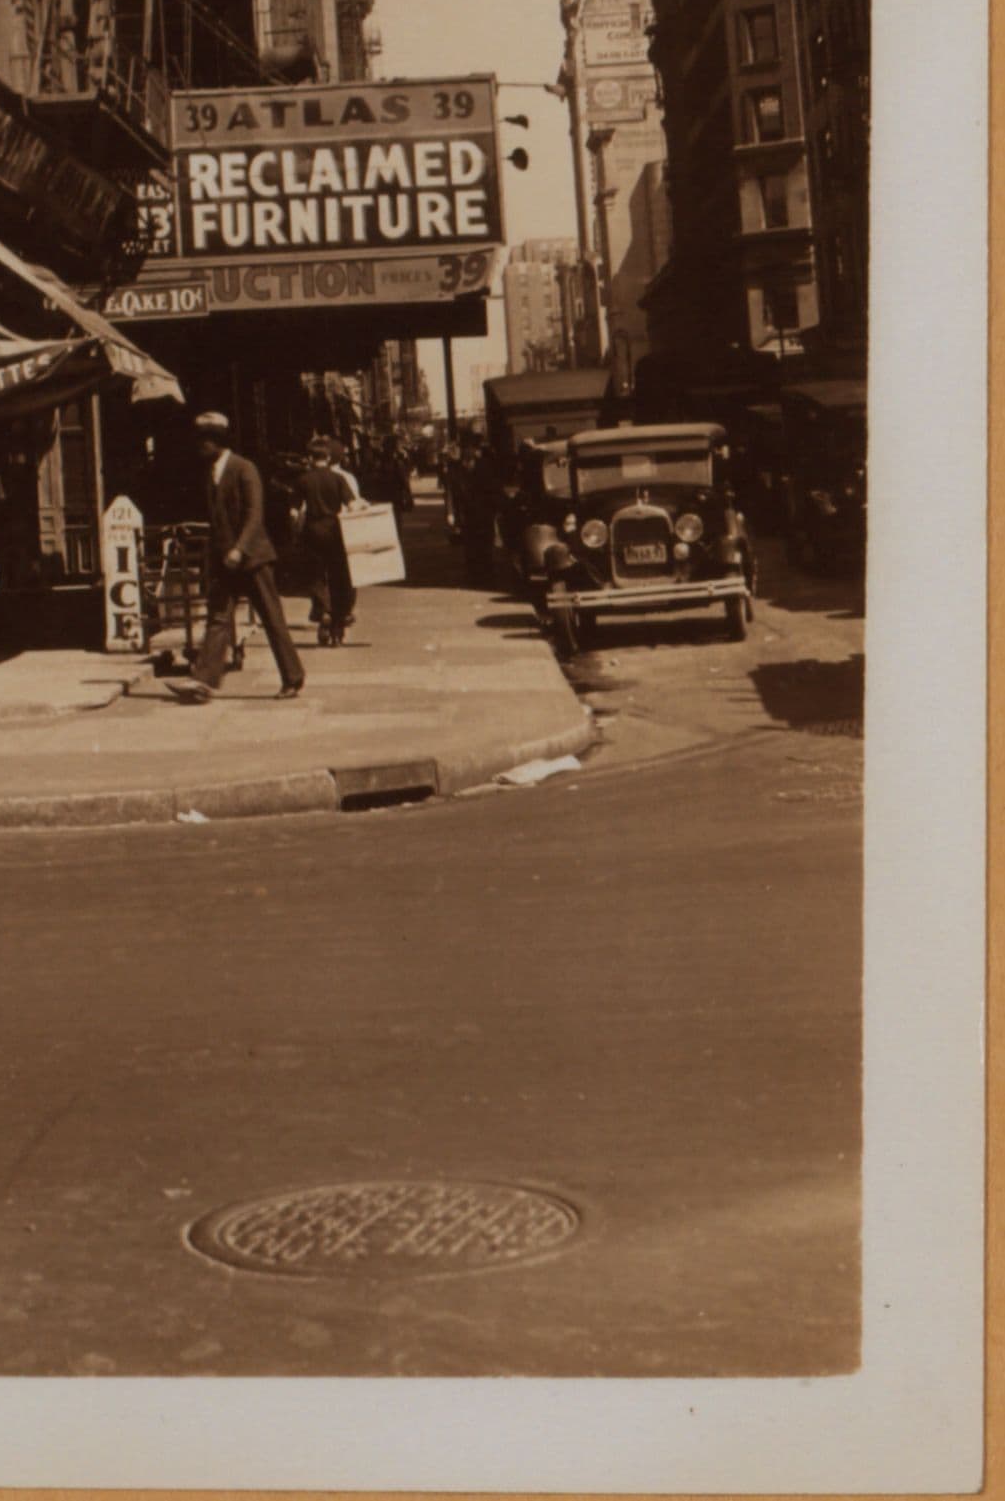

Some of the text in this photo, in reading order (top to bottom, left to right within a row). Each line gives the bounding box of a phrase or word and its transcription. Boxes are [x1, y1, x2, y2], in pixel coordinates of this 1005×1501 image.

[184, 90, 476, 134] 39 ATLAS 39
[188, 140, 486, 202] RECLAIMED
[192, 190, 489, 250] FURNITURE
[206, 260, 377, 306] UCTION
[437, 252, 488, 293] 39
[109, 546, 139, 641] ICE
